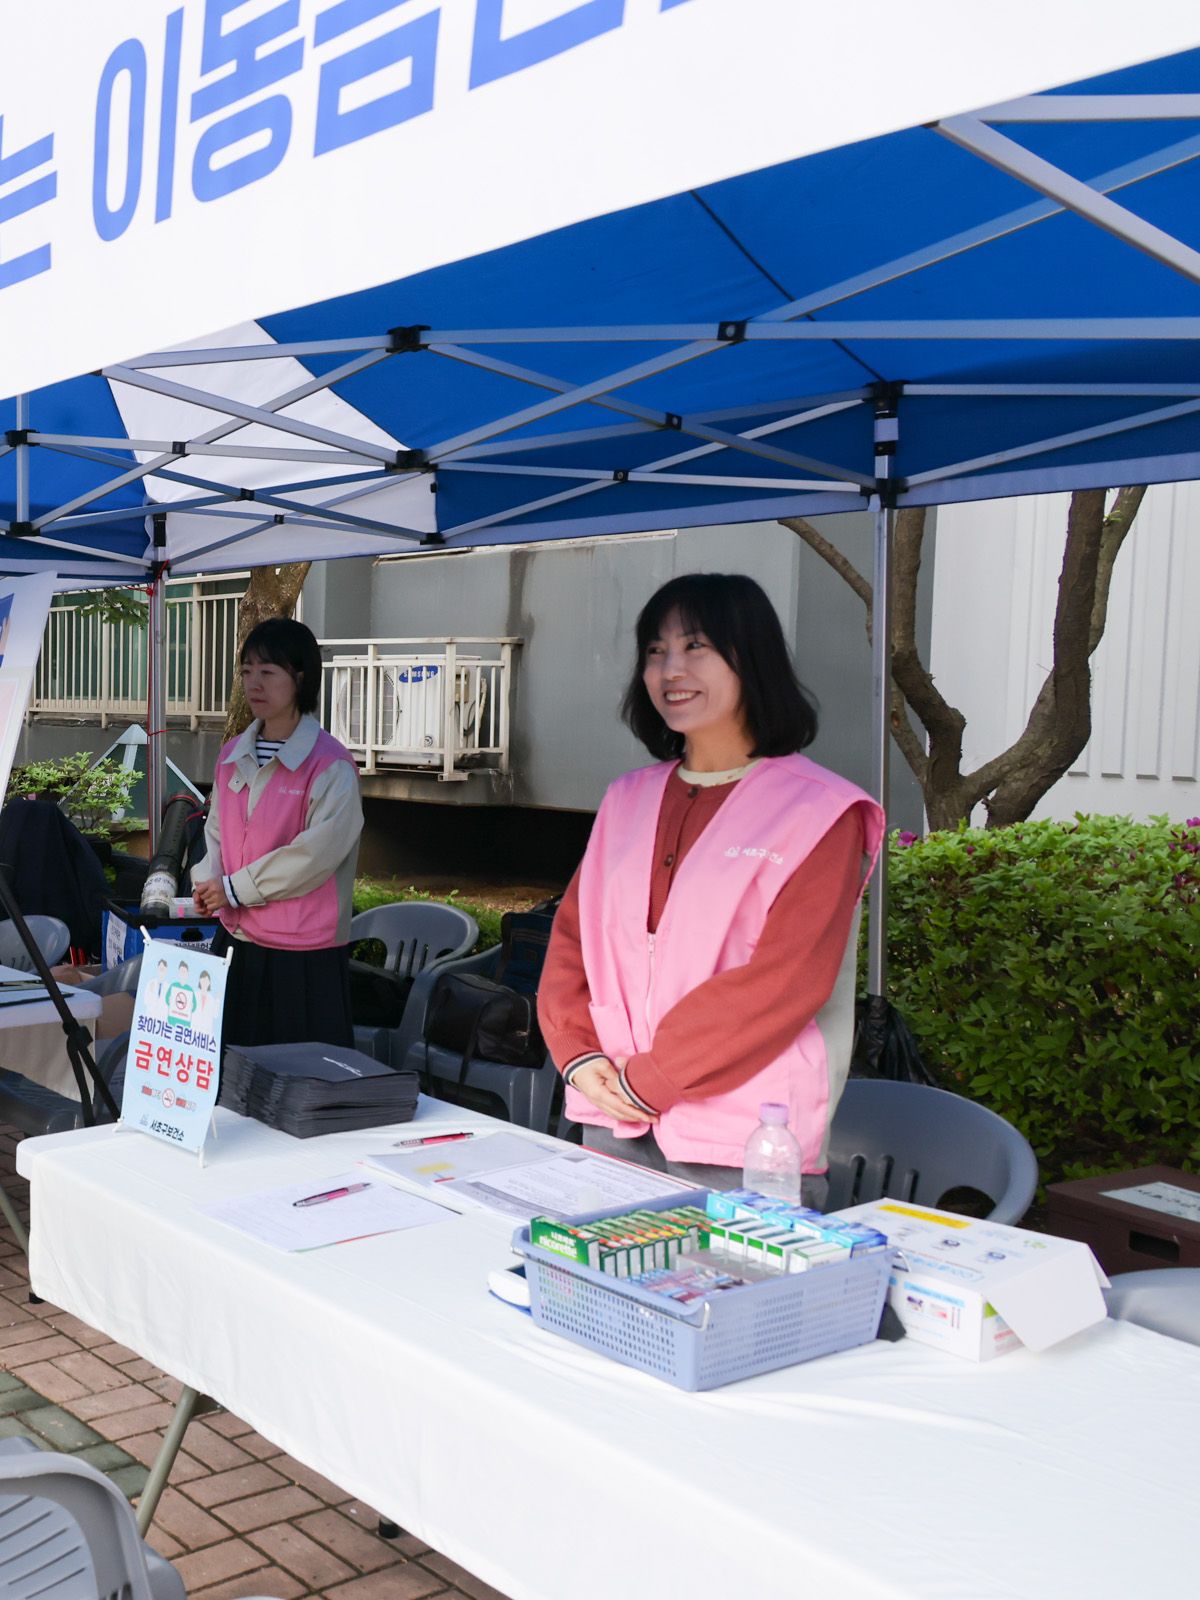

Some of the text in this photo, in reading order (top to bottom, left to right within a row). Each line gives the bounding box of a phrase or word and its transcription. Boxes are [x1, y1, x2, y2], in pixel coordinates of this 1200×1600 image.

[137, 1015, 217, 1053] 찾아가는 금연서비스
[135, 1040, 214, 1090] 금연상담
[150, 1119, 185, 1141] 서초구보건소
[539, 1235, 577, 1258] nicorette
